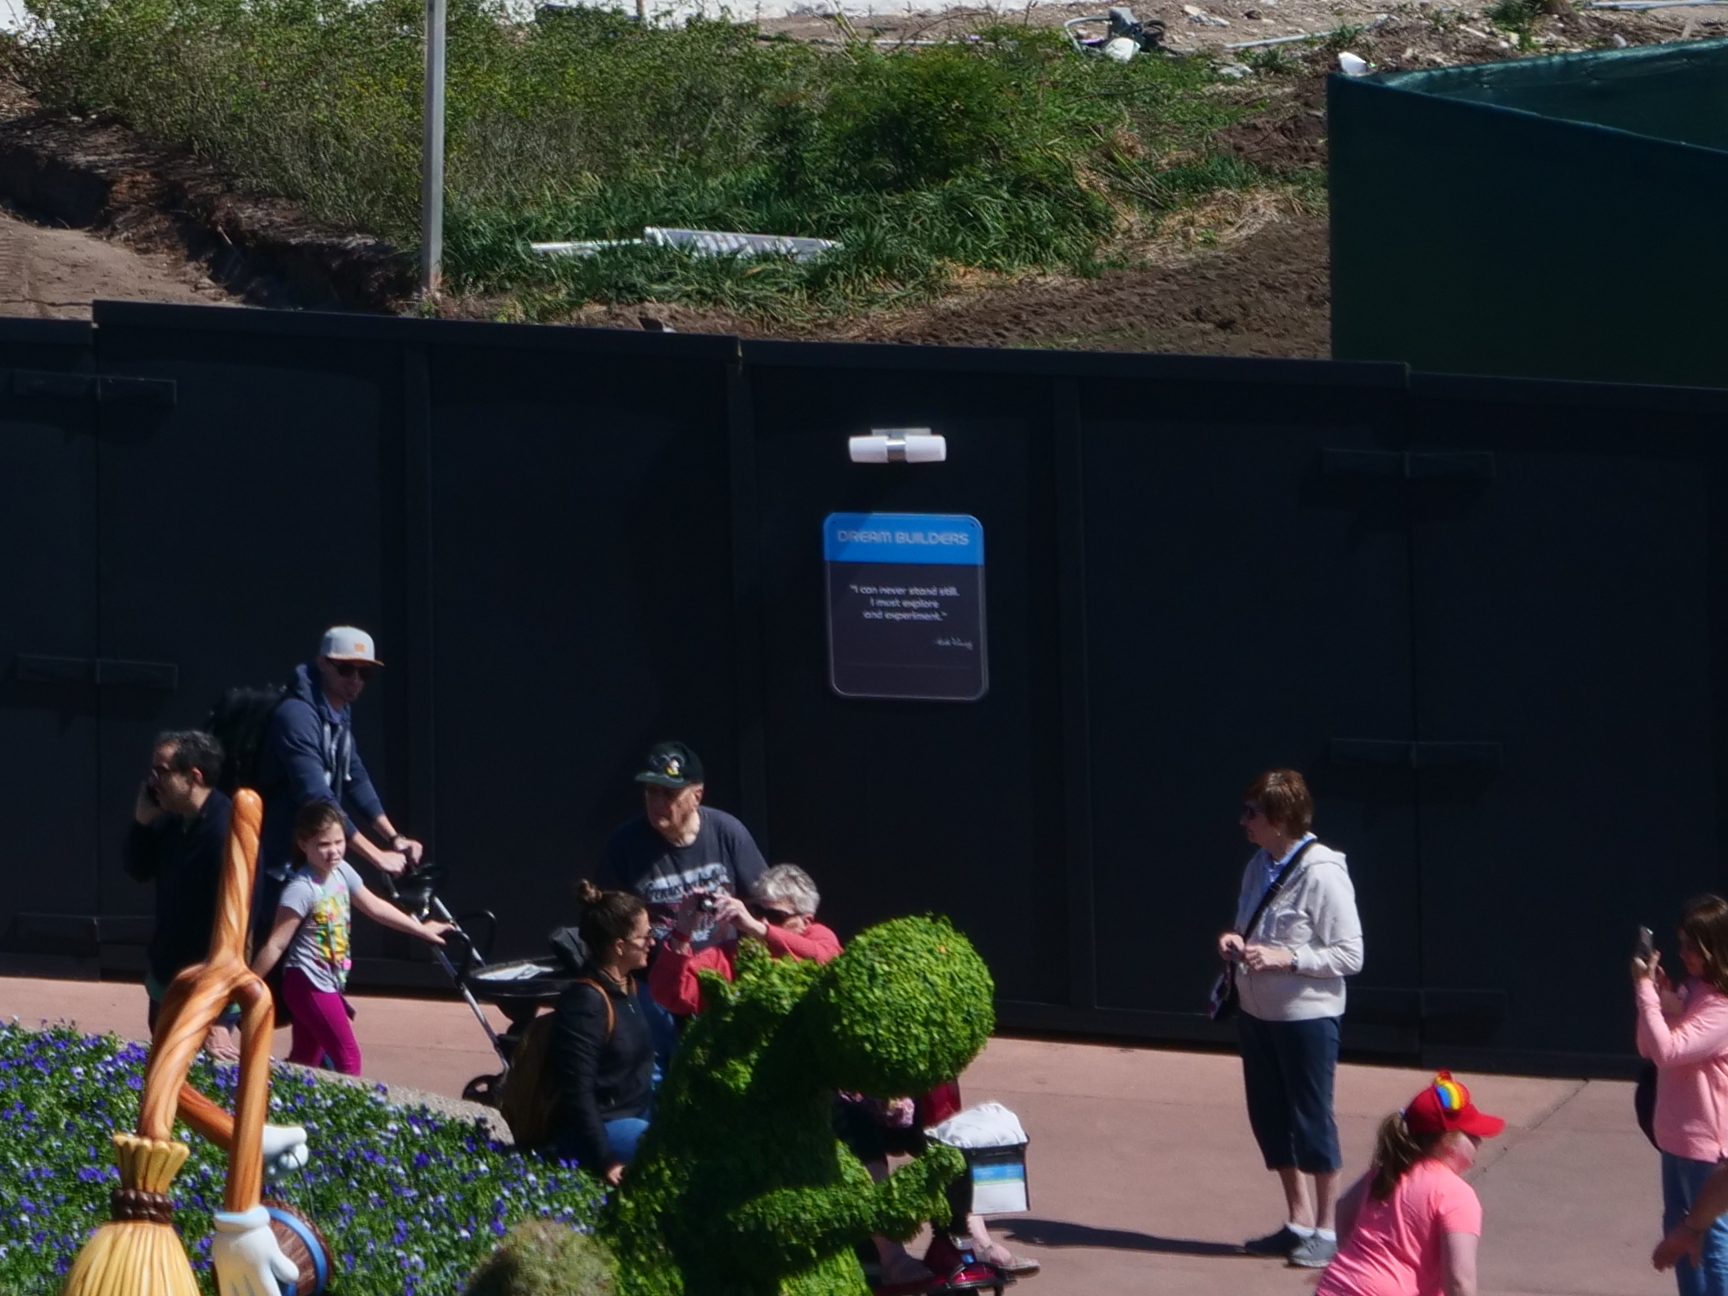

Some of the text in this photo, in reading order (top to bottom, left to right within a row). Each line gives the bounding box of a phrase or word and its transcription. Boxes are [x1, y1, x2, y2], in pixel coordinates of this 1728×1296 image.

[838, 530, 969, 545] DREAM BUILDERS
[860, 587, 878, 595] can
[879, 587, 906, 595] never
[909, 586, 938, 596] stand
[876, 598, 901, 607] must
[902, 598, 940, 609] explore
[863, 610, 883, 619] and
